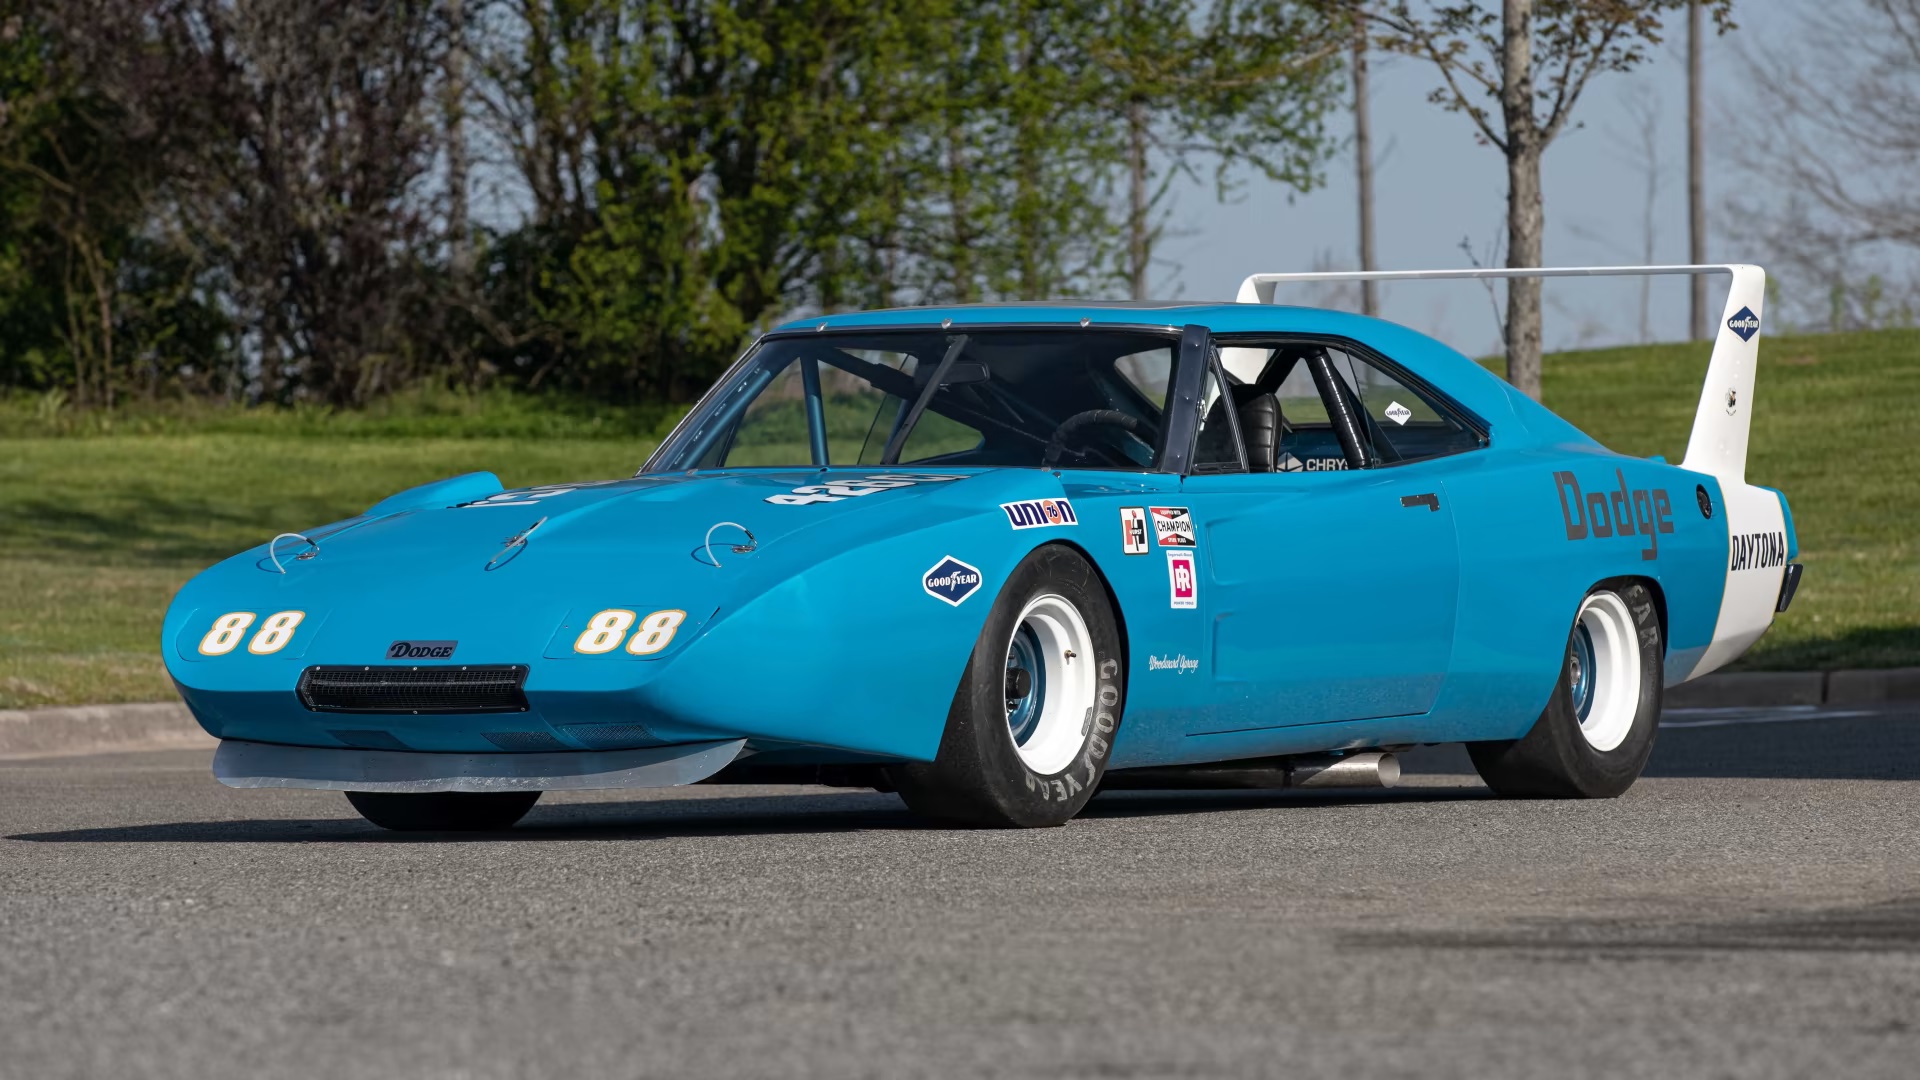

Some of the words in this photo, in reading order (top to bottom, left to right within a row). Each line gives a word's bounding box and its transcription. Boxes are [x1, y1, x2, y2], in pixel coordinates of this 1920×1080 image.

[1046, 505, 1058, 518] 76
[1157, 521, 1192, 532] CHAMPION
[1553, 468, 1674, 560] Dodge
[1731, 531, 1785, 571] DAYTONA
[927, 573, 977, 588] GOODYEAR
[197, 610, 306, 656] 88
[573, 608, 687, 656] 88
[1025, 658, 1118, 802] GOODYEAR
